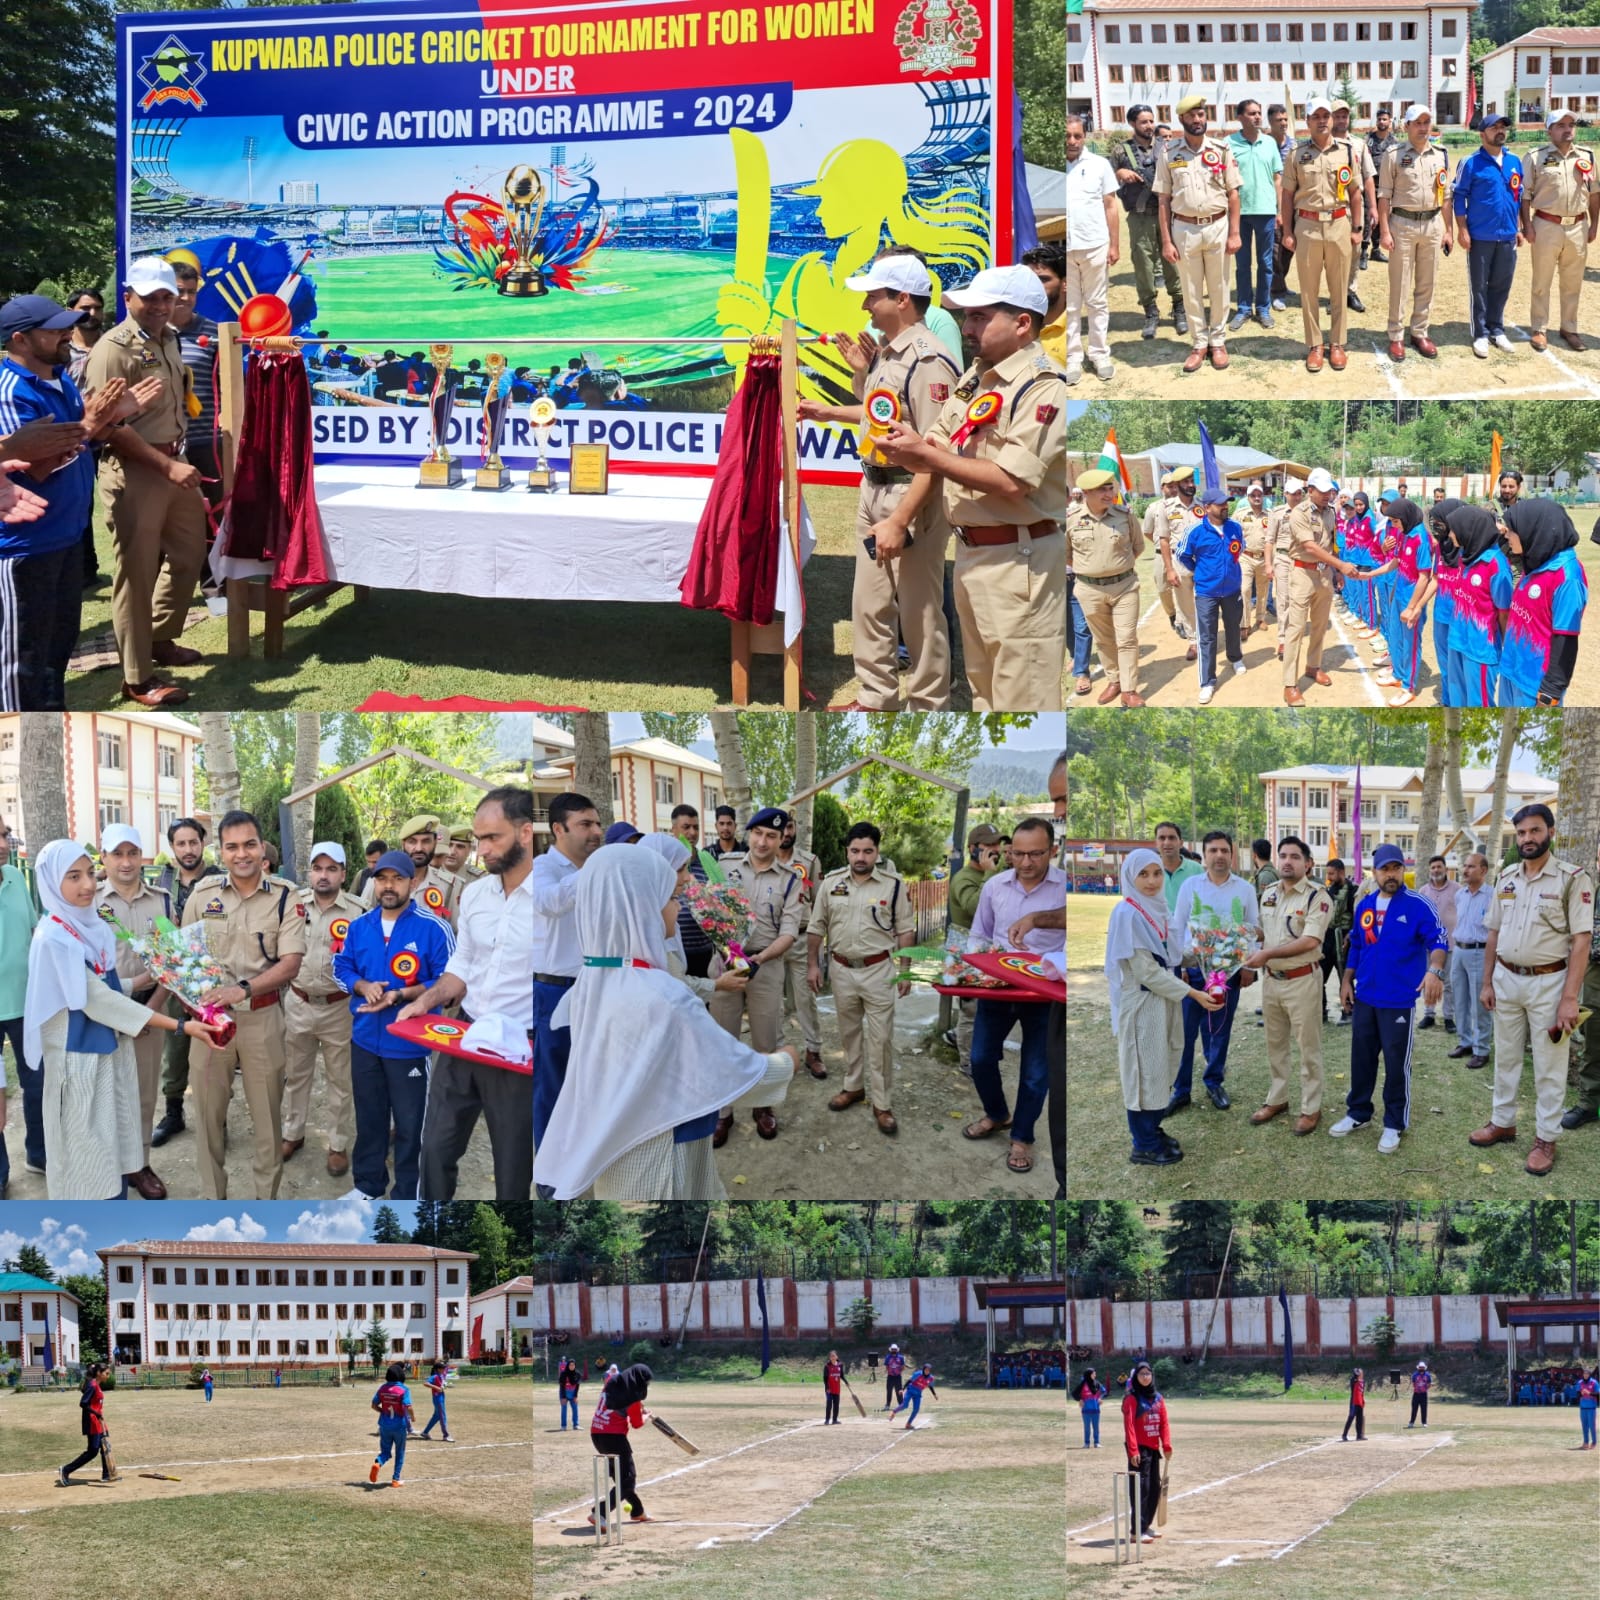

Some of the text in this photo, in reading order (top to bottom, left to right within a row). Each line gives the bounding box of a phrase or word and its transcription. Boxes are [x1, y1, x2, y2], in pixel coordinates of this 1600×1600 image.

[211, 0, 875, 73] KUPWARA POLICE CRICKET TOURNAMENT FOR WOMEN
[480, 65, 576, 95] UNDER
[298, 112, 369, 143] CIVIC
[376, 108, 470, 140] ACTION
[480, 99, 665, 138] PROGRAMME
[694, 93, 776, 127] 2024
[313, 414, 369, 444] SED
[378, 415, 419, 444] BY
[588, 419, 704, 454] POLICE
